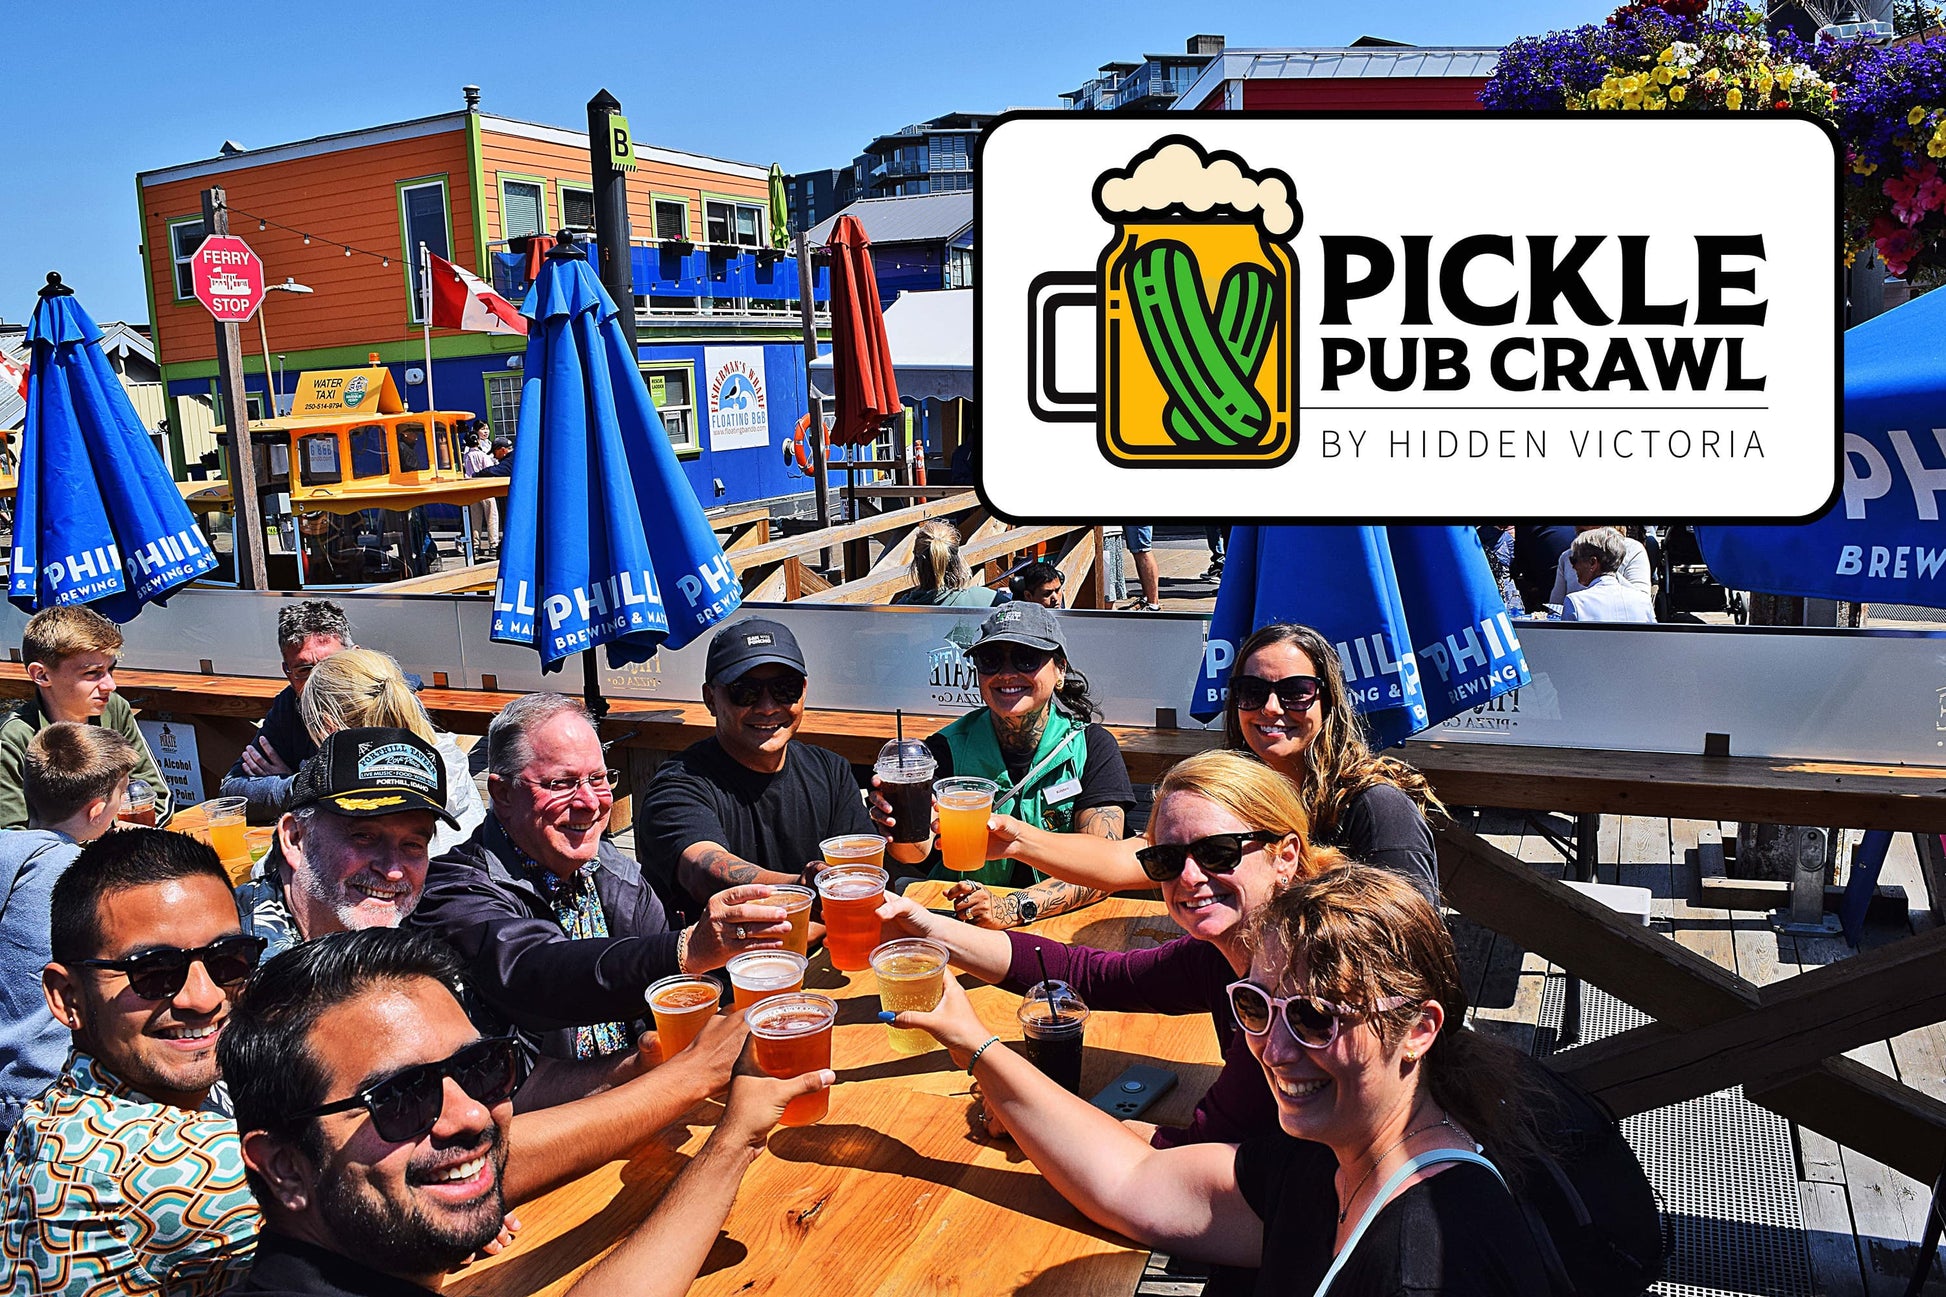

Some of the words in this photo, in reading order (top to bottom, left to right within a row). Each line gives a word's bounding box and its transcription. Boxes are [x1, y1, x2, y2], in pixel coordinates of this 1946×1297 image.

[614, 128, 629, 157] B
[203, 250, 250, 265] FERRY
[212, 298, 250, 312] STOP
[314, 379, 343, 388] WATER
[710, 360, 747, 413] FISHERMAN'S
[748, 368, 765, 410] WHARF
[316, 390, 336, 399] TAXI
[712, 412, 749, 428] FLOATING
[751, 411, 766, 424] B&B
[55, 578, 118, 606] BREWING
[555, 615, 627, 650] BREWING
[632, 611, 643, 625] &
[359, 745, 408, 767] PORTHILL
[164, 758, 192, 771] Alcohol
[175, 789, 195, 800] Point
[410, 782, 429, 792] IDAHO
